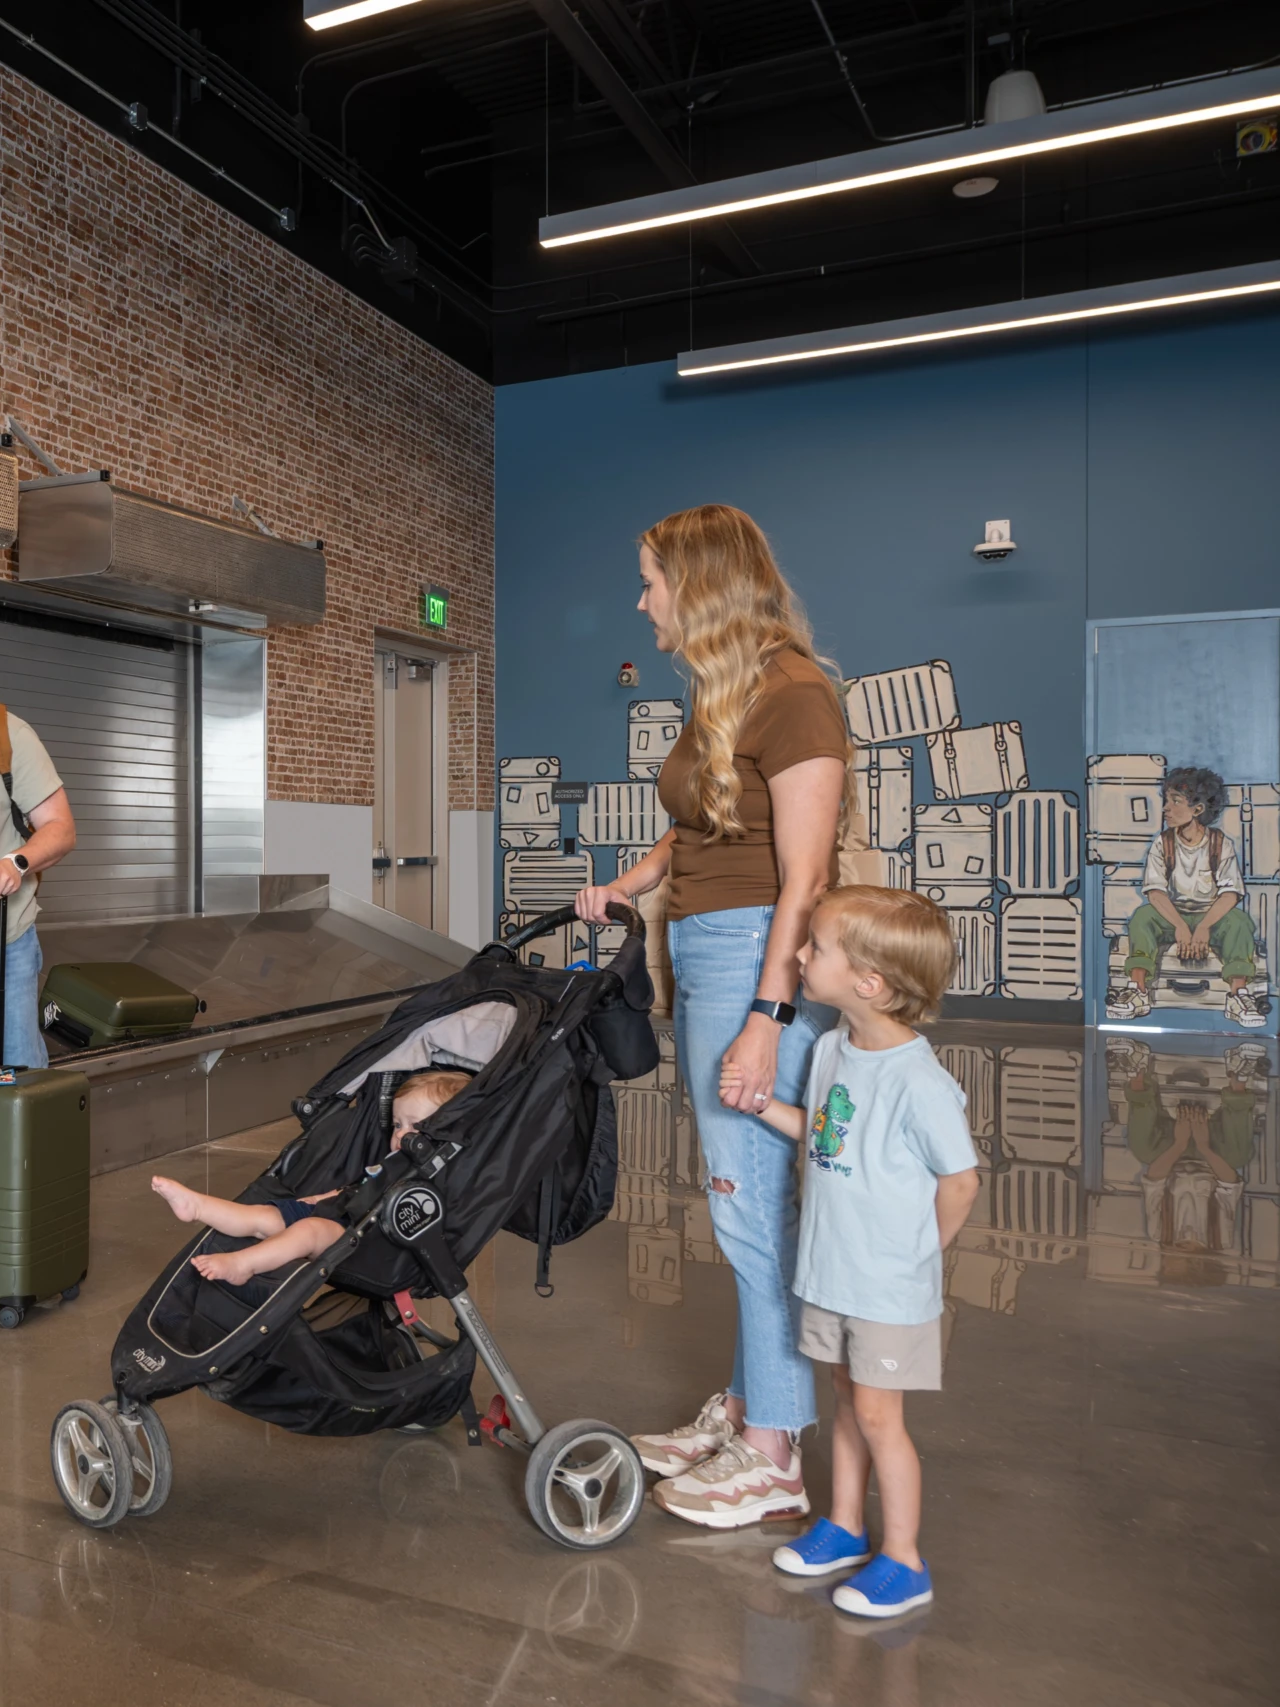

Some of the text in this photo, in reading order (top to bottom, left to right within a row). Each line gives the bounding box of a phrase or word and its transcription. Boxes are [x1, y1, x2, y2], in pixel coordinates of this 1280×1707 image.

[430, 597, 444, 625] EXIT
[398, 1204, 414, 1220] city
[400, 1209, 421, 1231] mini
